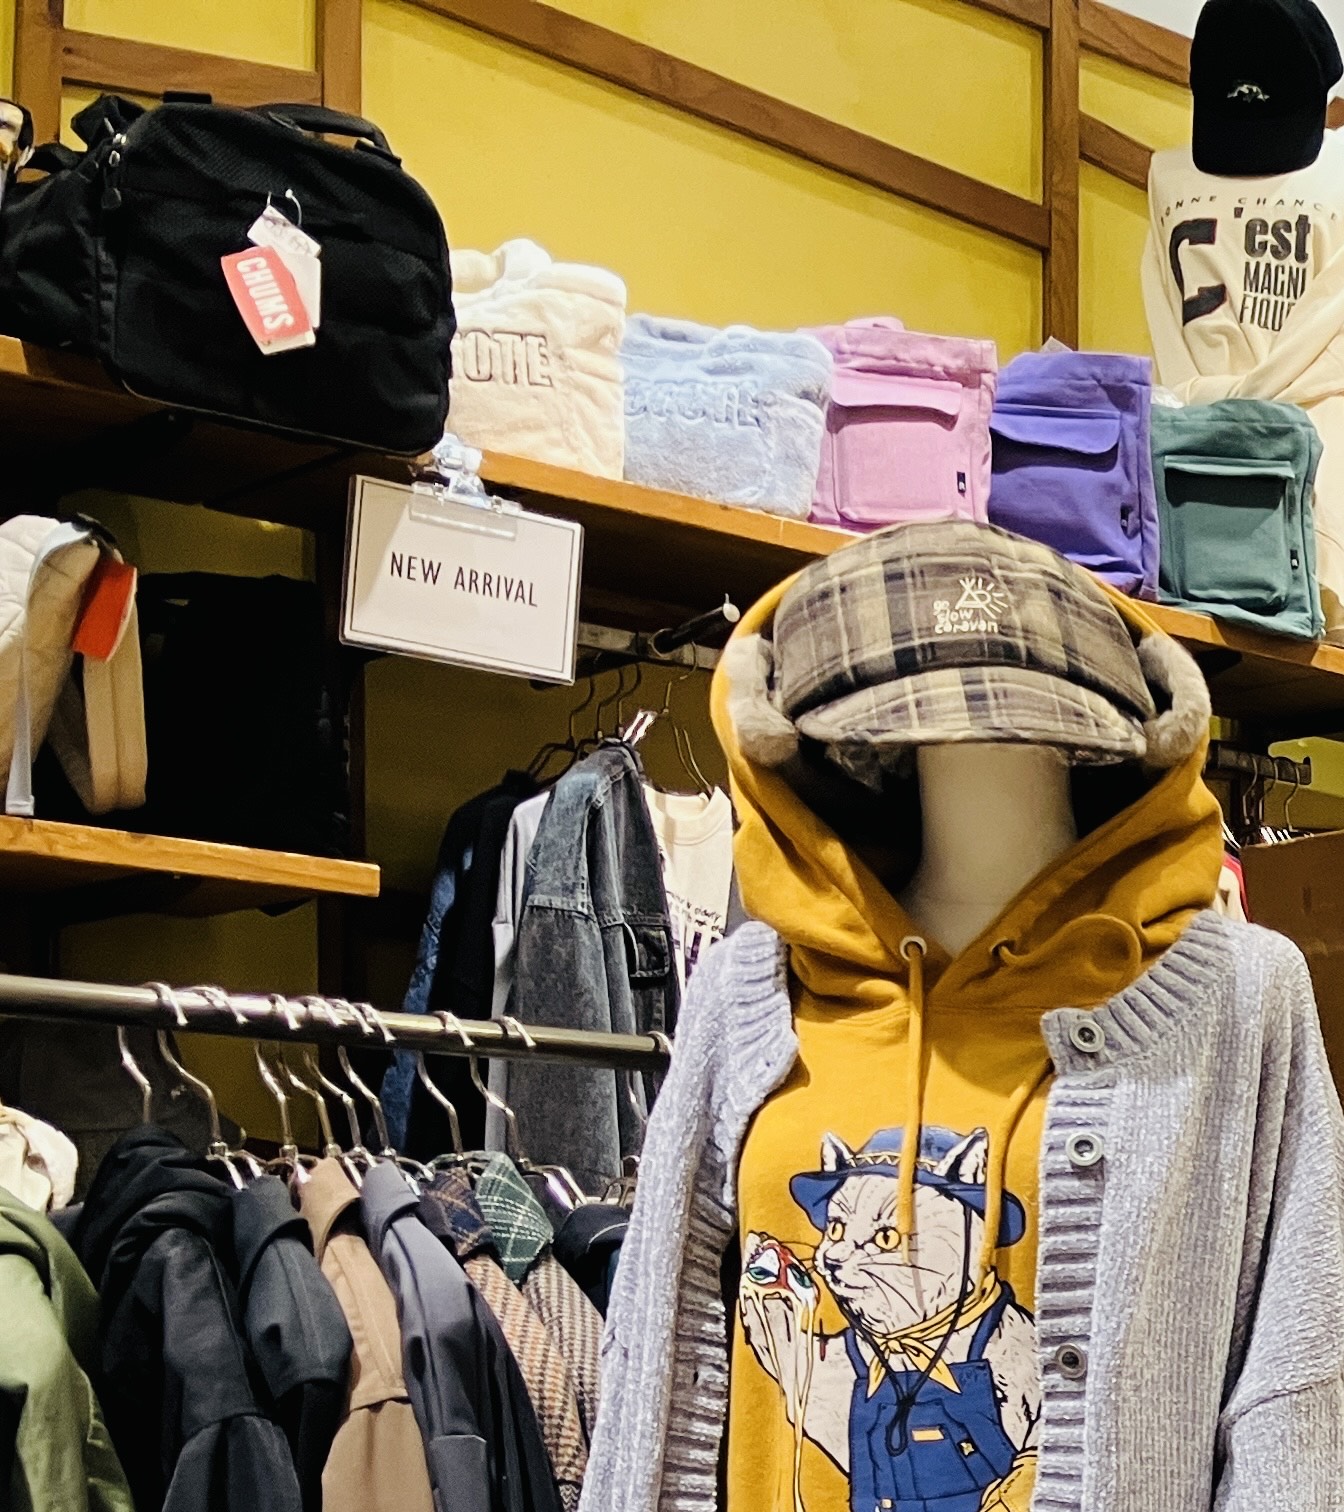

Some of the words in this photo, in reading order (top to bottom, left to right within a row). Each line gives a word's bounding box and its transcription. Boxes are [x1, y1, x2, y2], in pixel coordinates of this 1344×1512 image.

[236, 256, 295, 330] CHUMS
[390, 551, 442, 586] NEW
[453, 566, 539, 608] ARRIVAL
[934, 619, 998, 634] caravan
